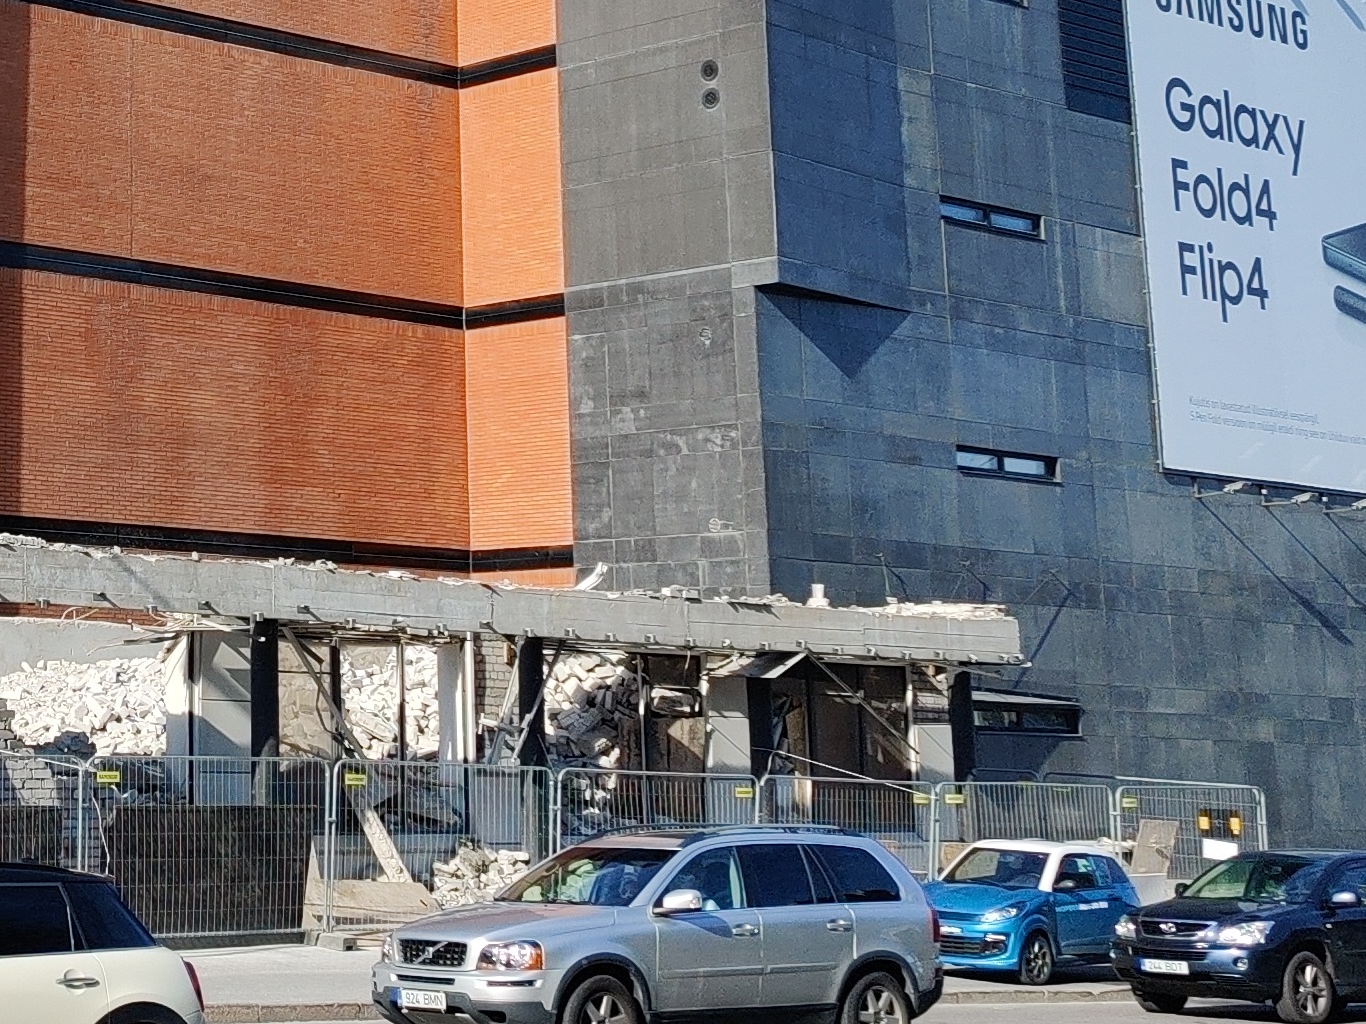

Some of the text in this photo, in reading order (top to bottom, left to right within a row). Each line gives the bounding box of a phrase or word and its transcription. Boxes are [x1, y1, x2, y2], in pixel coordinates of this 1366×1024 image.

[1165, 77, 1305, 176] Galaxy
[1171, 157, 1277, 232] Fold4
[1177, 241, 1269, 323] Flip4
[405, 992, 443, 1007] 924 BMN
